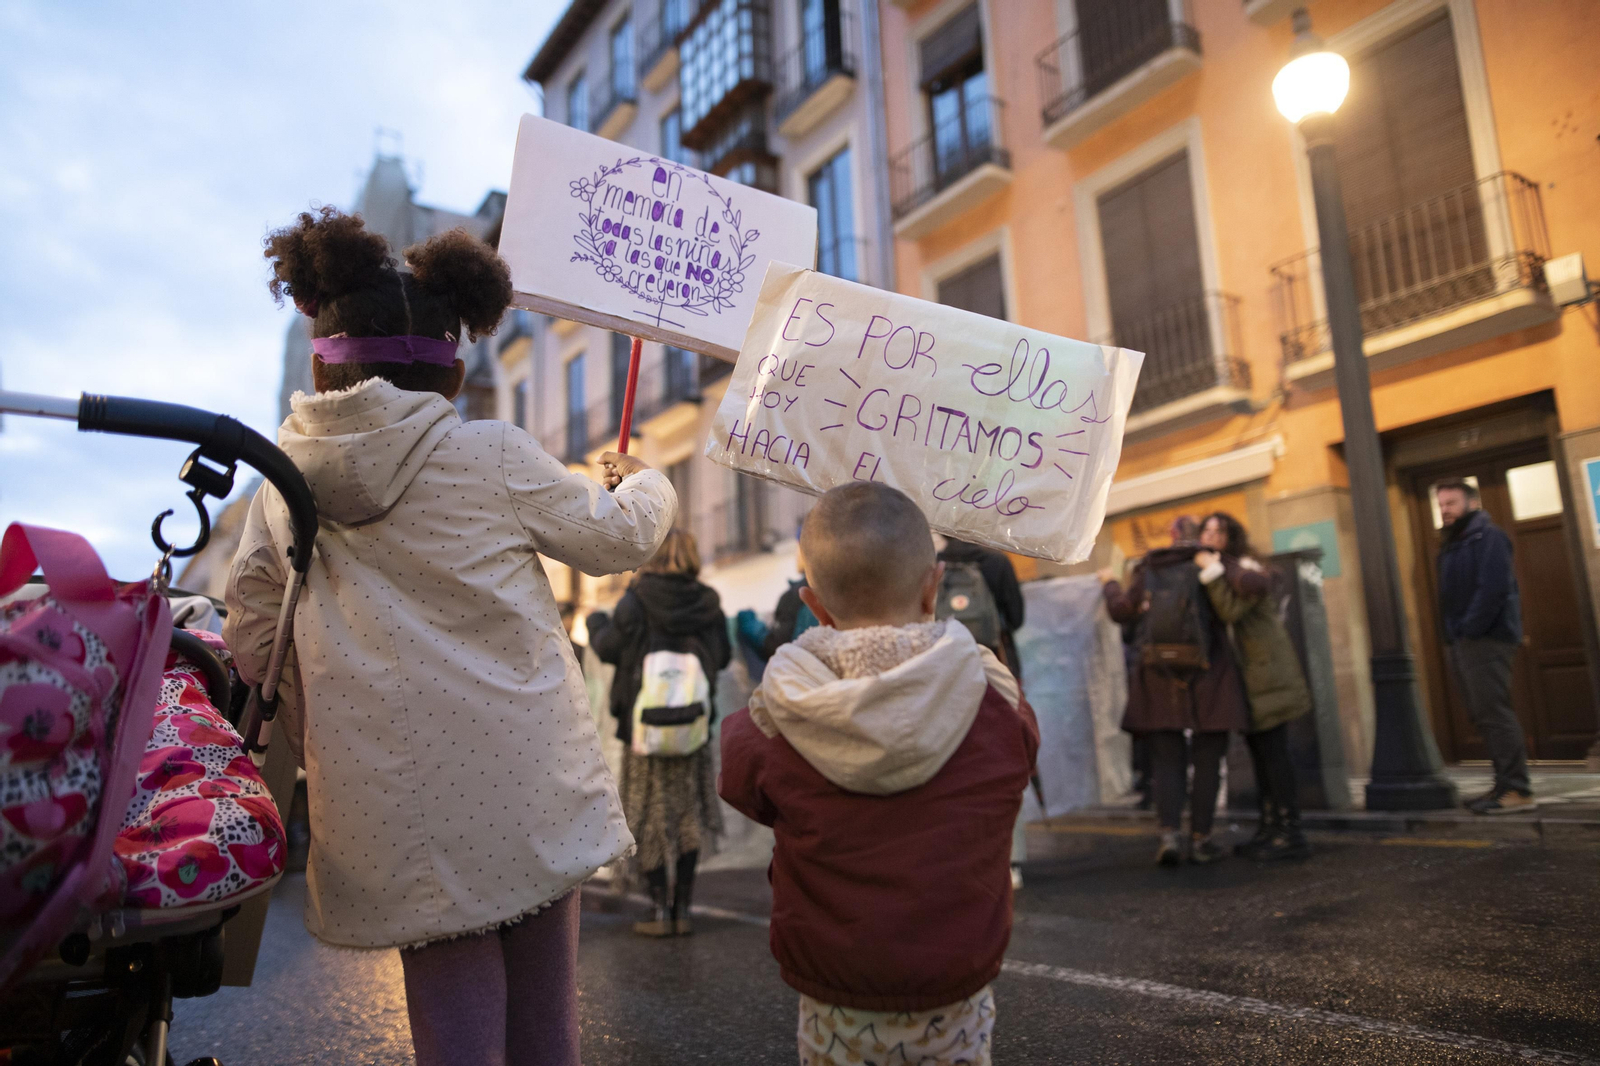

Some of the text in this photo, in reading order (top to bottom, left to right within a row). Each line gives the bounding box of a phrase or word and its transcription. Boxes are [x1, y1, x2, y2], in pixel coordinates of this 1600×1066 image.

[652, 167, 682, 201] en
[603, 184, 720, 243] memoria de
[595, 206, 736, 273] todas las niñas
[605, 240, 714, 284] a las que NO
[629, 270, 701, 302] creyeron
[758, 354, 815, 387] QUE
[782, 298, 1112, 424] ES POR ellas
[749, 384, 799, 412] HOY
[856, 388, 1043, 469] GRITAMOS
[726, 419, 1046, 516] HACIA EL cielo
